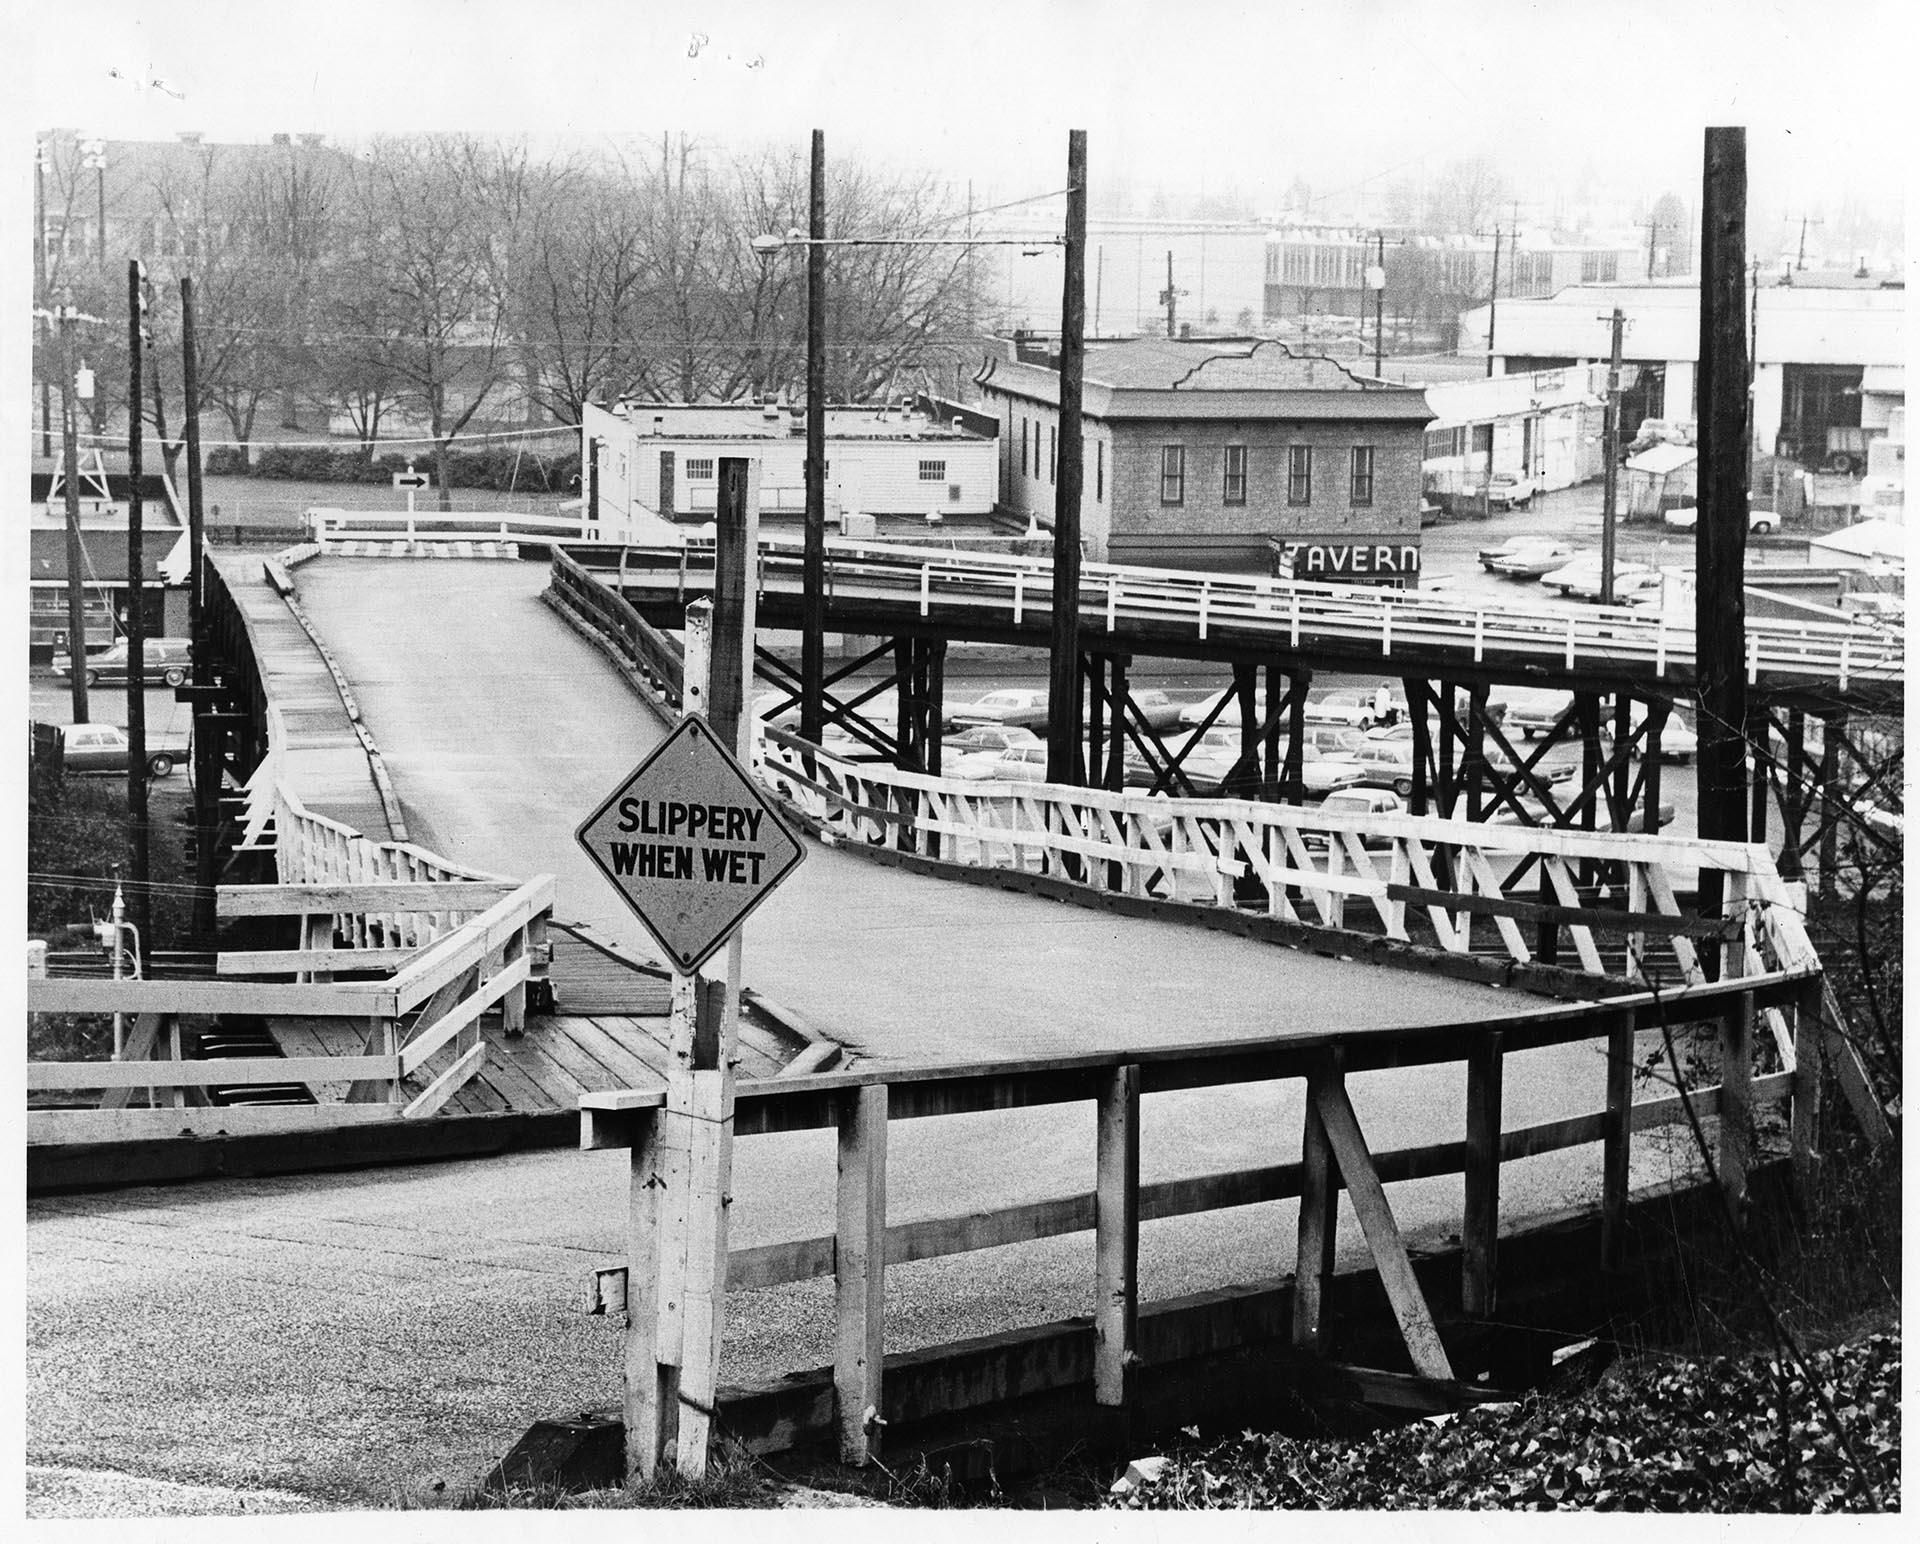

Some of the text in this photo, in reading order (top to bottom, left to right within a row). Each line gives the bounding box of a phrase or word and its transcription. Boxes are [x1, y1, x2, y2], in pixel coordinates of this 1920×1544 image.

[617, 797, 764, 842] SLIPPERY
[610, 842, 766, 885] WHEN WET
